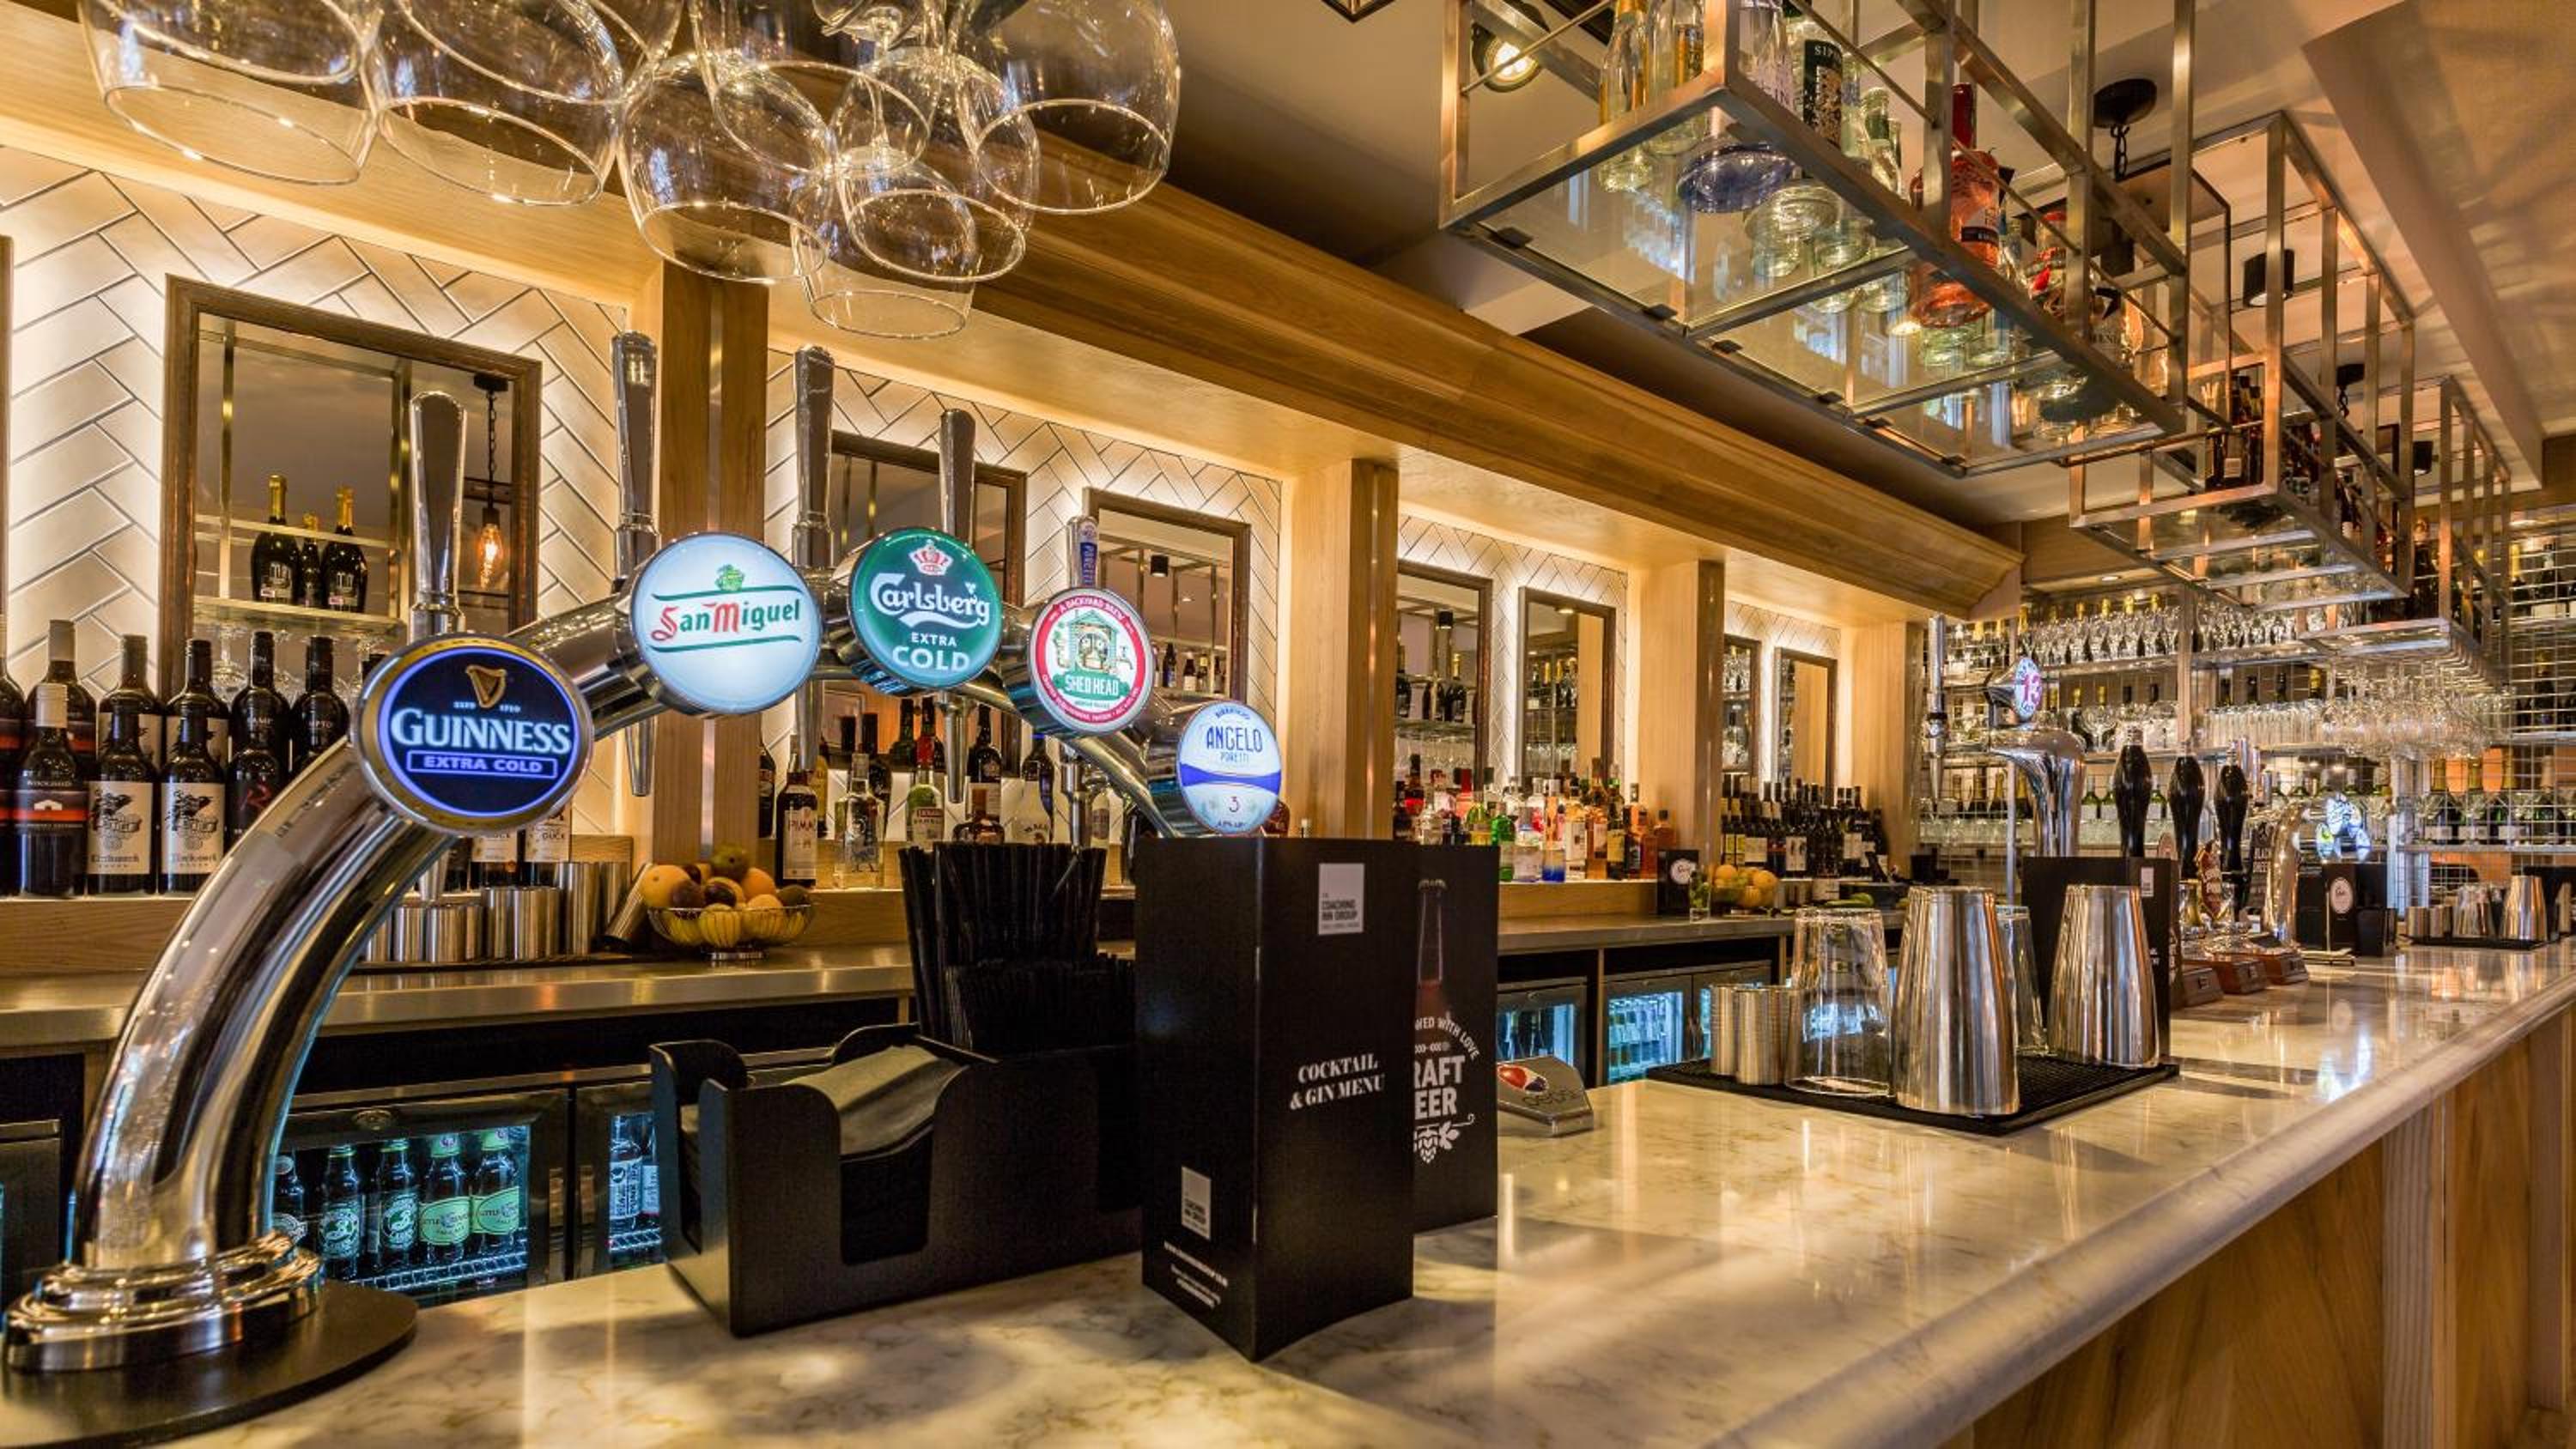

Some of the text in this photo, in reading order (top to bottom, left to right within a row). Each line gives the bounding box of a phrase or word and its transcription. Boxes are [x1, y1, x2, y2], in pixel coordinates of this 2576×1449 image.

[870, 573, 990, 627] Carlsberg
[651, 598, 800, 641] San Miguel
[911, 632, 957, 647] EXTRA
[892, 646, 969, 671] COLD
[1065, 675, 1120, 696] SHED HEAD
[391, 707, 572, 754] GUINNESS
[1206, 725, 1264, 753] ANGELO
[423, 755, 543, 773] EXTRA COLD
[1229, 796, 1241, 813] 3
[1437, 1017, 1461, 1038] WITH
[1460, 1031, 1480, 1061] LOVE
[1297, 1052, 1379, 1084] COCKTAIL
[1289, 1073, 1386, 1111] & GIN MENU
[1415, 1087, 1457, 1121] EER
